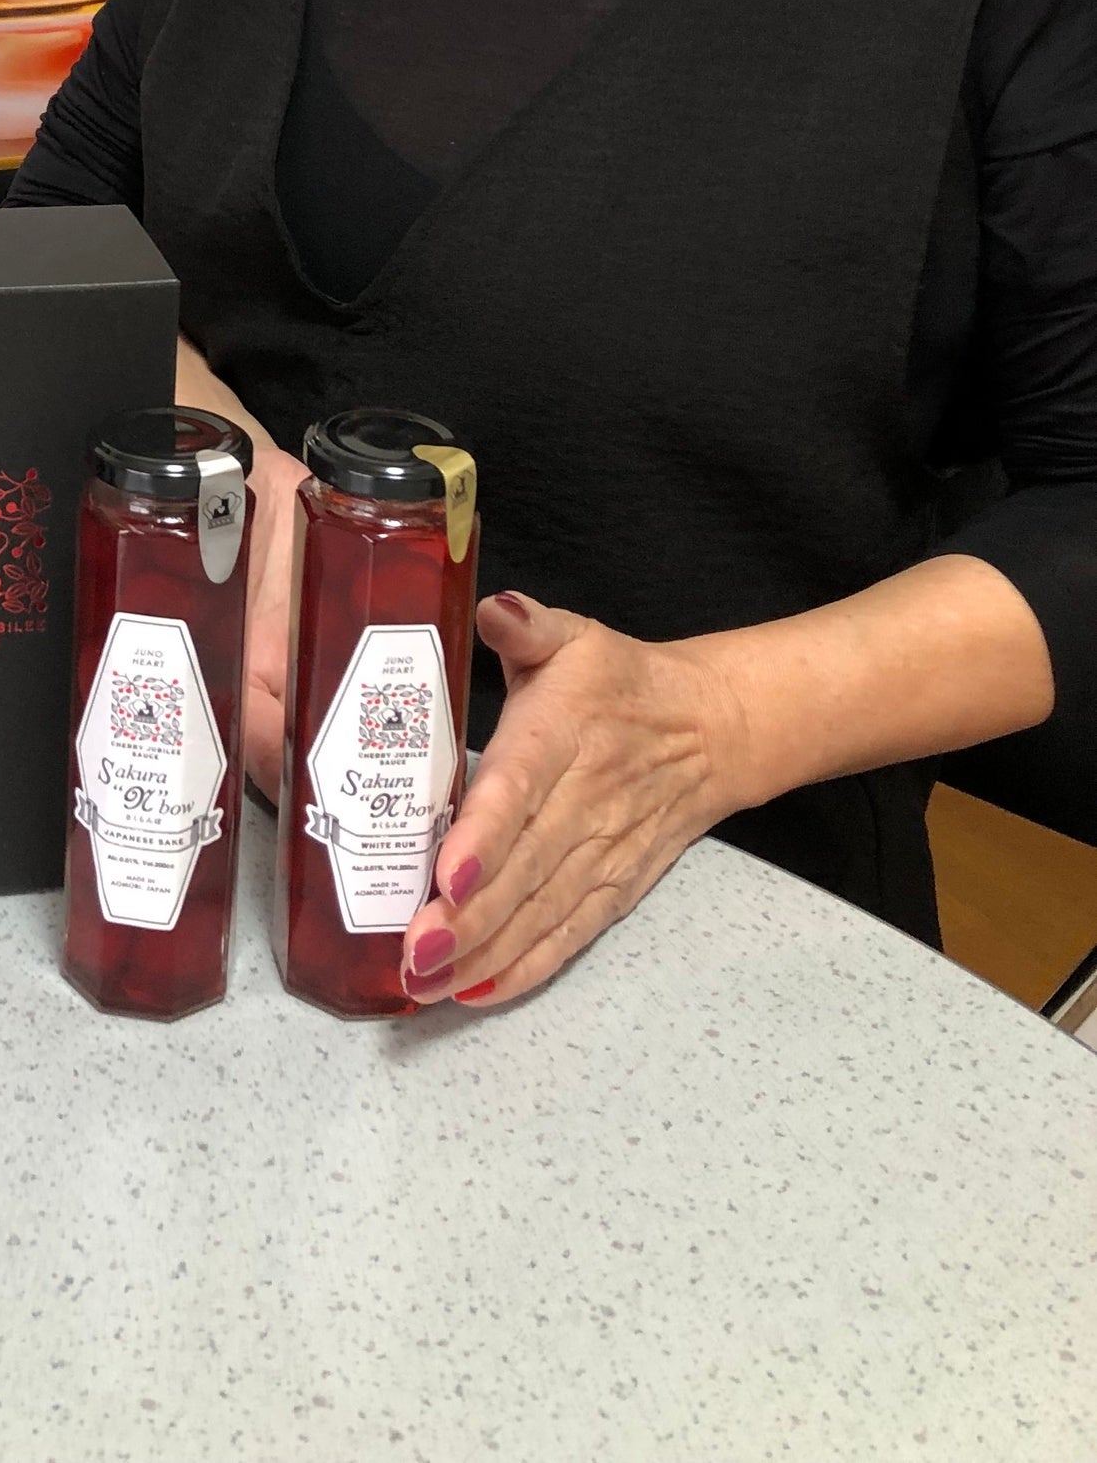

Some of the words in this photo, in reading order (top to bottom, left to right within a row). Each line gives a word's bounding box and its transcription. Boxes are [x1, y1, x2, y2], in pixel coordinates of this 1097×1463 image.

[134, 648, 164, 659] JUNO
[132, 658, 165, 669] HEART
[384, 656, 414, 665] JUNO
[382, 665, 415, 675] HEART
[110, 740, 144, 752] CHERRY
[146, 744, 182, 756] JUBILEE
[132, 751, 160, 760] SAUCE
[358, 751, 392, 760] CHERRY
[393, 750, 428, 759] JUBILEE
[98, 757, 168, 785] Sakura
[340, 769, 414, 797] Sakura
[159, 799, 195, 816] bow
[104, 829, 154, 845] JAPANESE
[158, 837, 185, 846] SAKE
[361, 841, 391, 849] WHITE
